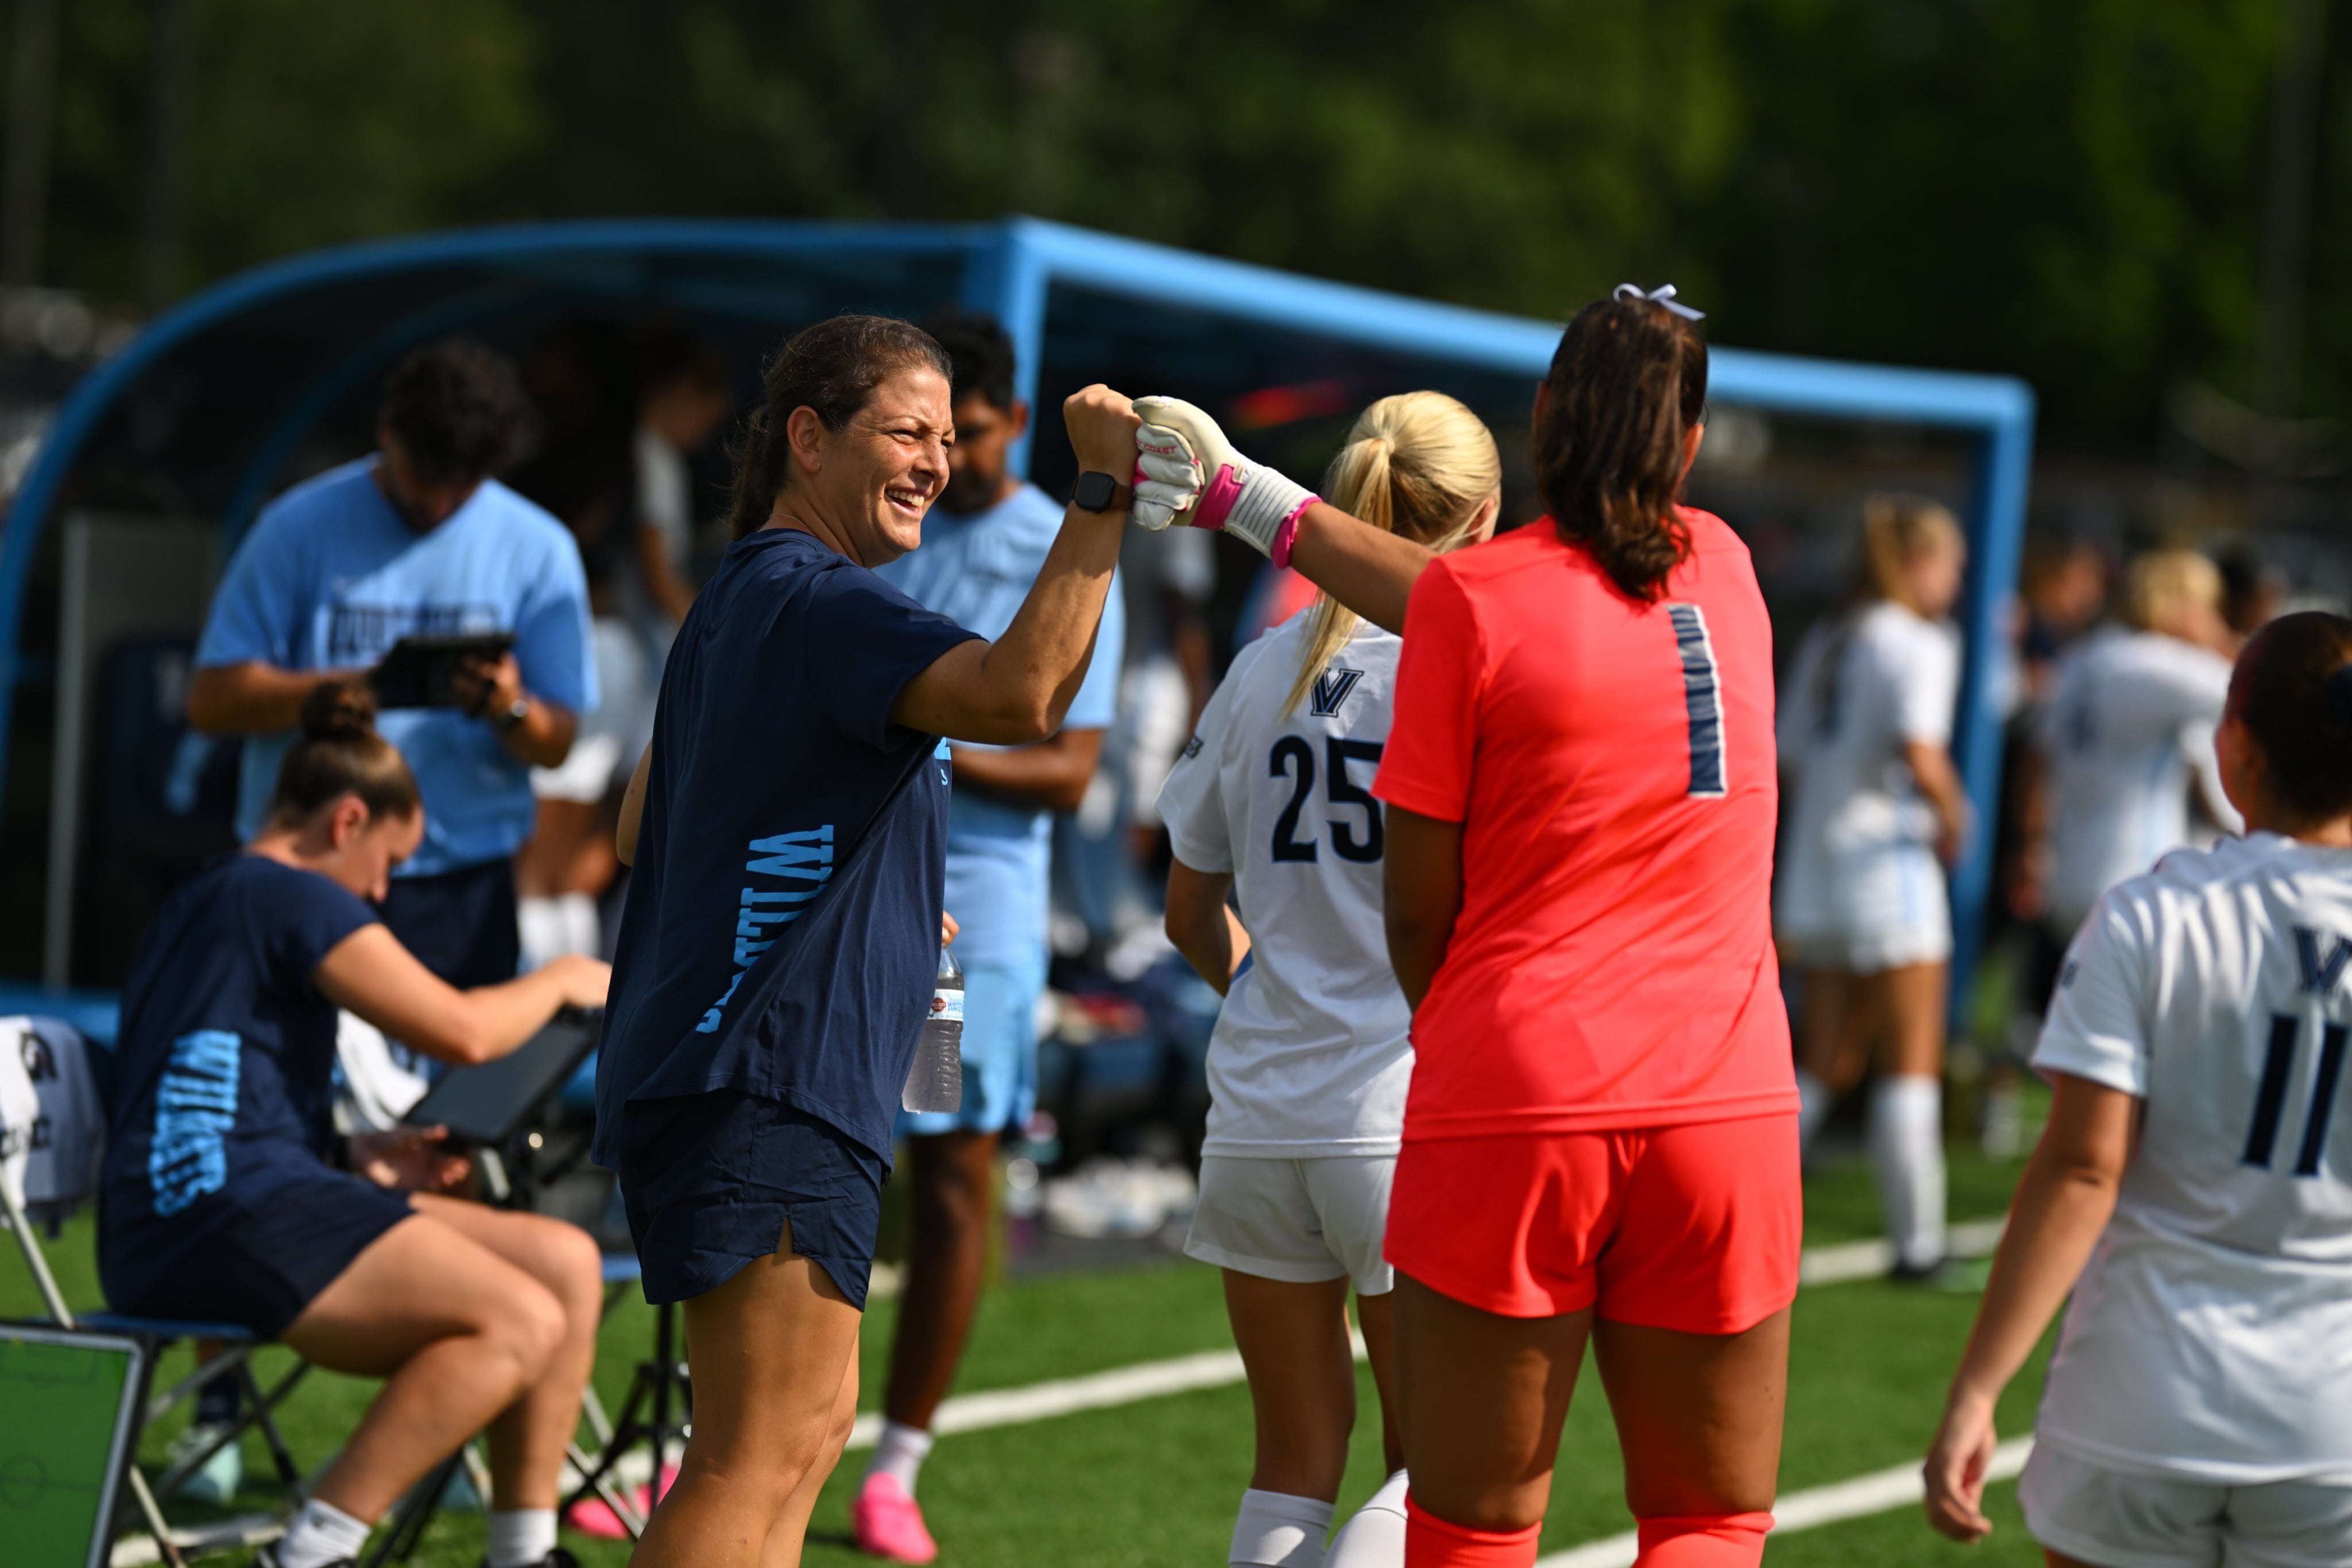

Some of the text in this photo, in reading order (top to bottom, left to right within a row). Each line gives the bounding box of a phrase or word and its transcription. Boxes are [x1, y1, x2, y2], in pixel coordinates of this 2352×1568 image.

[1143, 443, 1177, 455] COAST
[1310, 667, 1364, 718] V
[1664, 603, 1728, 798] 1
[1268, 733, 1386, 864] 25
[2293, 925, 2352, 995] V
[2239, 1012, 2349, 1177] 11
